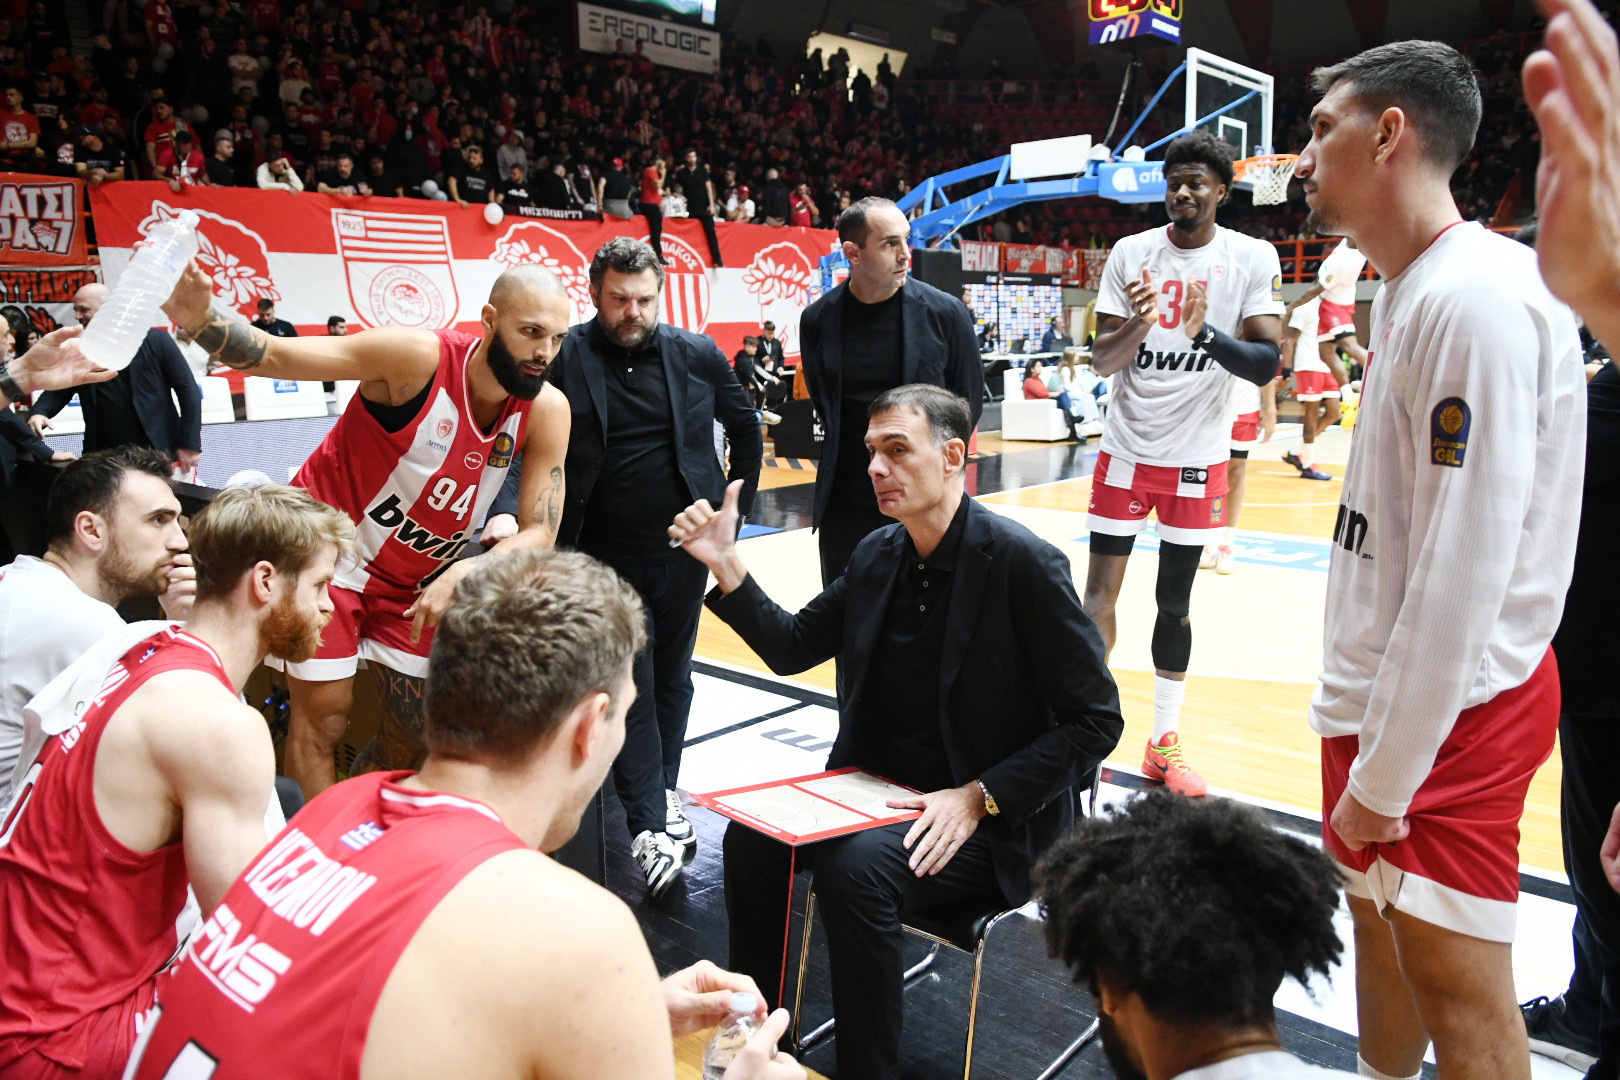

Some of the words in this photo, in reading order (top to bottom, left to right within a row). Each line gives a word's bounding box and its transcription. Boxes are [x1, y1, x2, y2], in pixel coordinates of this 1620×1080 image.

[341, 219, 364, 231] 1925
[490, 457, 508, 468] GBL
[427, 477, 477, 521] 94
[192, 902, 293, 1005] FMS
